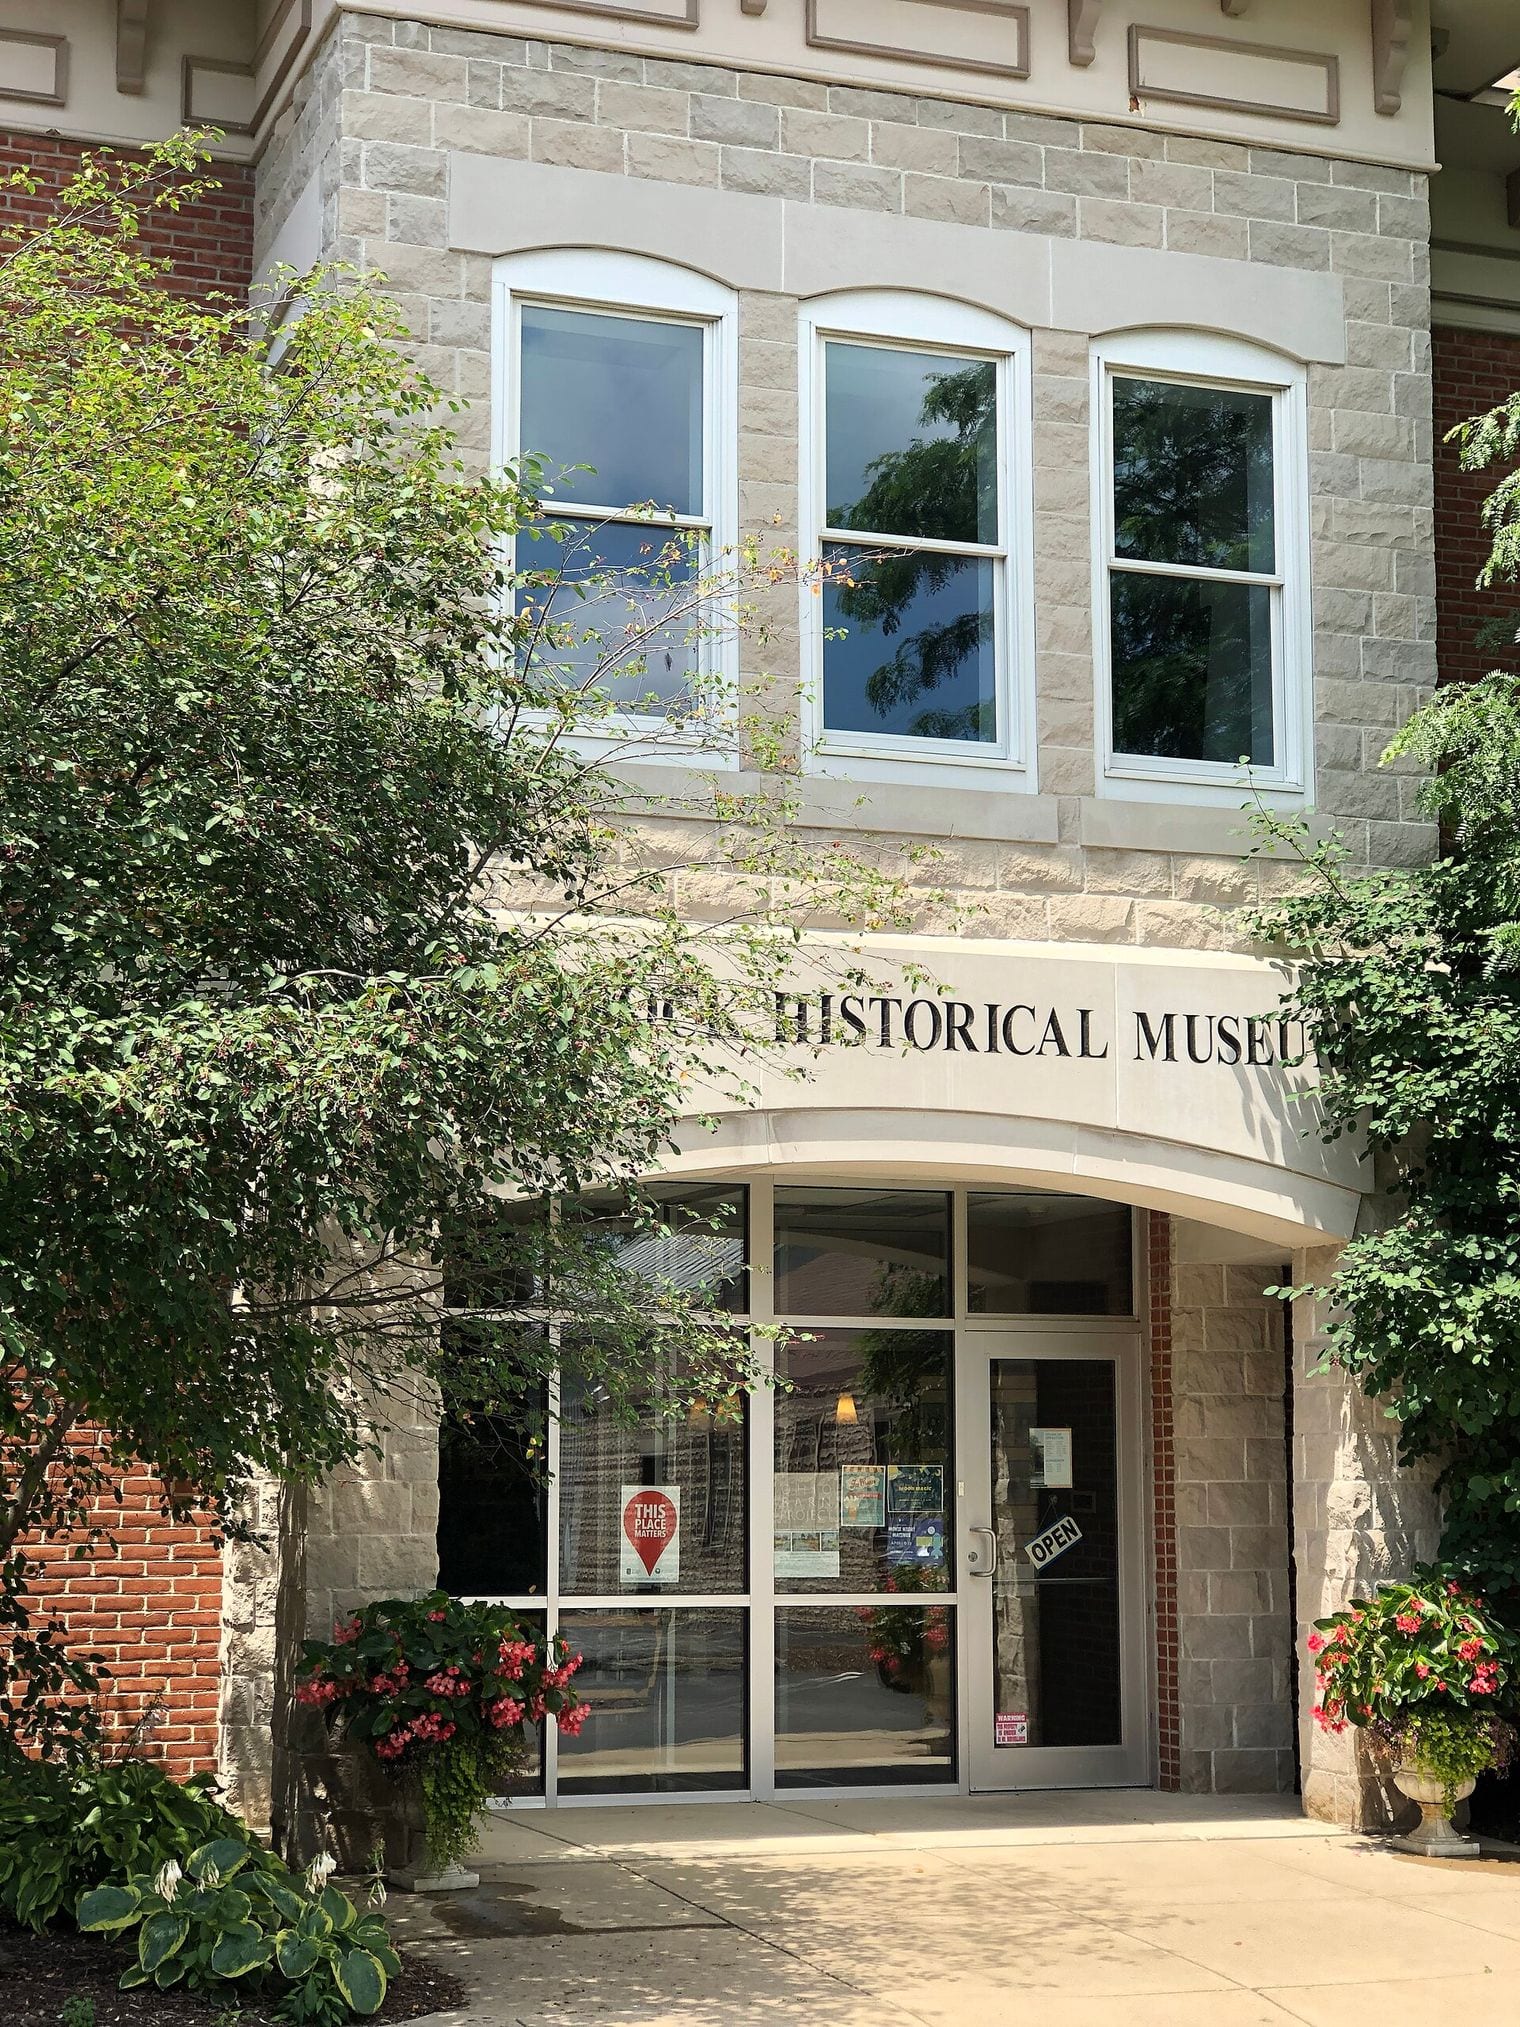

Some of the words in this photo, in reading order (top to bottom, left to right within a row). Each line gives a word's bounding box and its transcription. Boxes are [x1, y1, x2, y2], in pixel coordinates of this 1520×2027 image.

[774, 991, 1108, 1059] HISTORICAL
[634, 1503, 666, 1519] THIS
[634, 1519, 667, 1530] PLACE
[634, 1530, 667, 1538] MATTERS
[1031, 1519, 1079, 1563] OPEN
